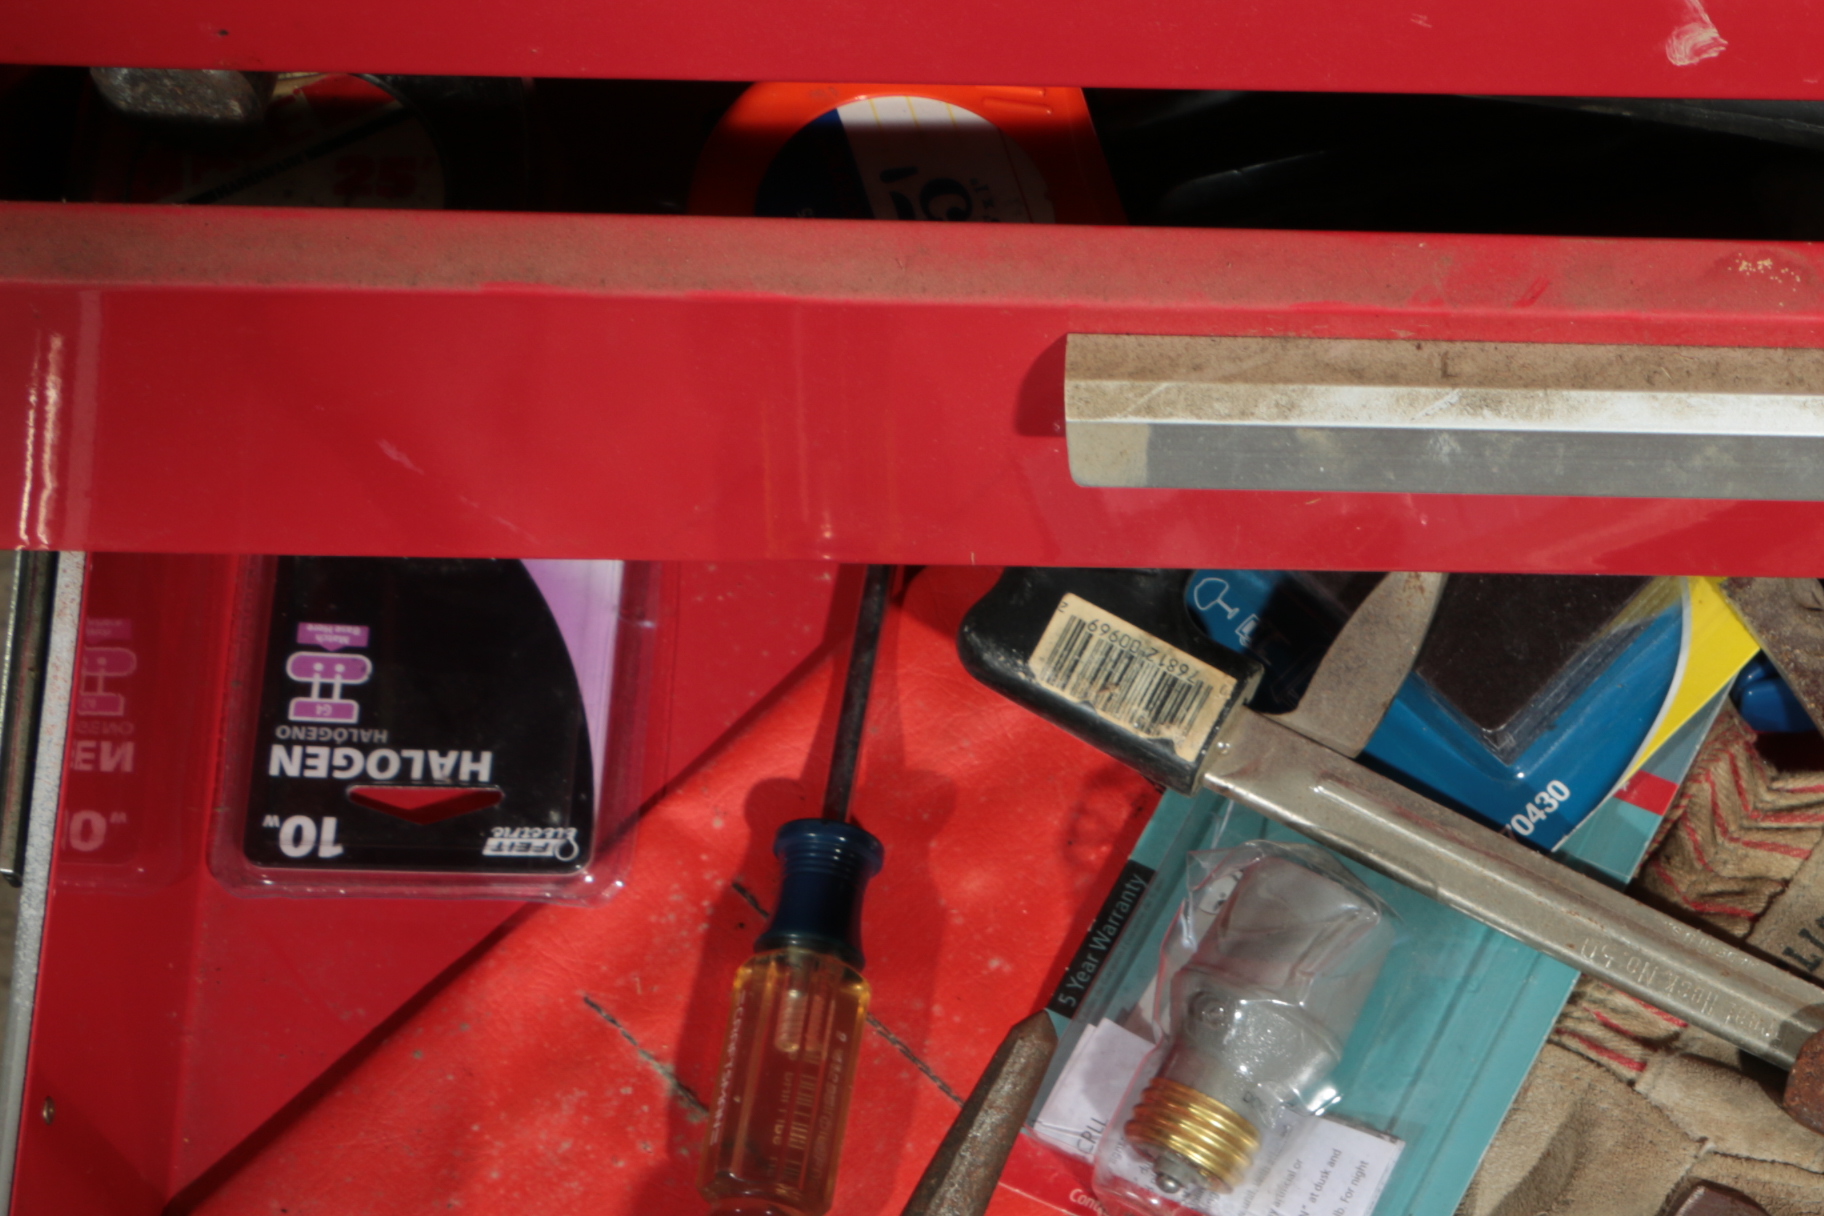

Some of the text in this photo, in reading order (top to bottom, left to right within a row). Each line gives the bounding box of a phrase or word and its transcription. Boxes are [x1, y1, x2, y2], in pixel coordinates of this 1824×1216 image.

[274, 724, 388, 745] HALÓGENO
[267, 743, 494, 783] HALOGEN
[491, 841, 550, 853] FEIT
[1057, 871, 1150, 1009] 5 Year Warranty
[1292, 1158, 1304, 1170] or
[1325, 1147, 1342, 1168] and
[1311, 1166, 1332, 1193] dusk
[1340, 1186, 1356, 1205] For
[1348, 1158, 1372, 1188] night
[1307, 1191, 1320, 1204] at
